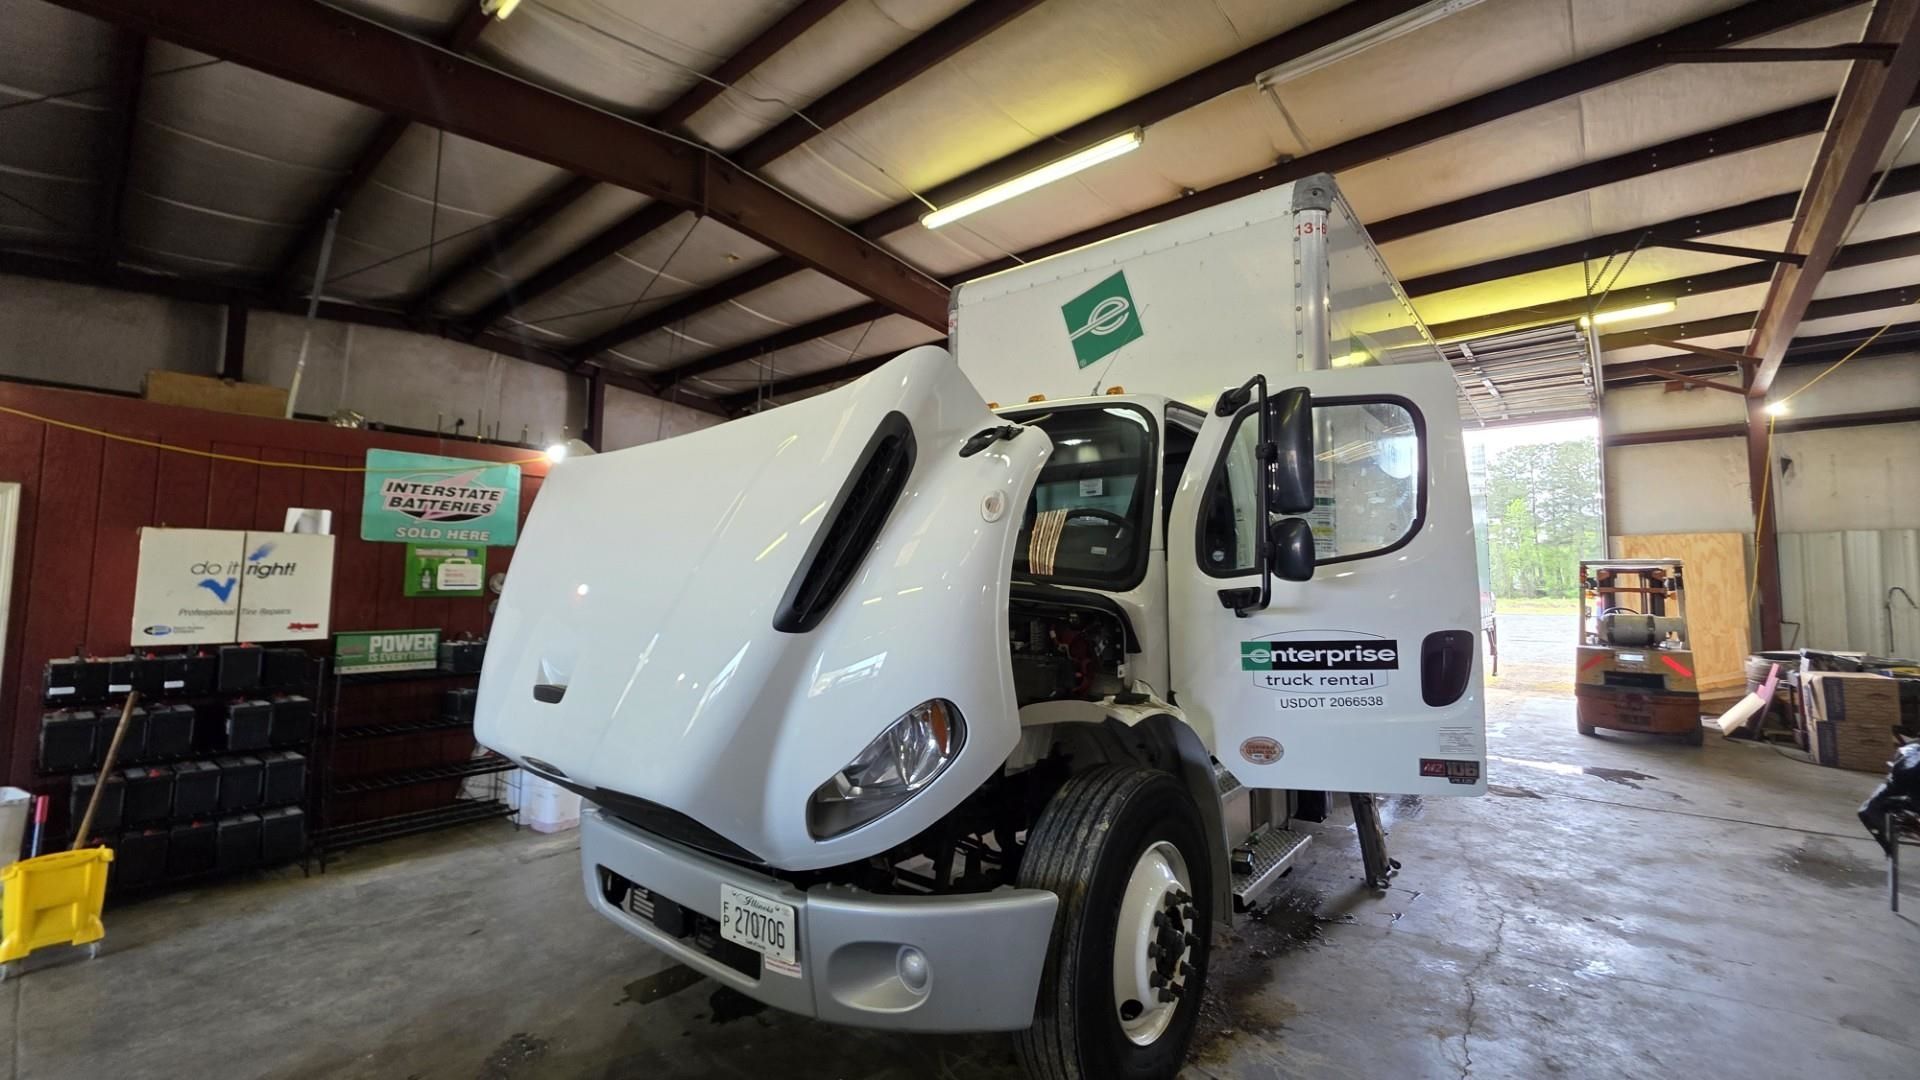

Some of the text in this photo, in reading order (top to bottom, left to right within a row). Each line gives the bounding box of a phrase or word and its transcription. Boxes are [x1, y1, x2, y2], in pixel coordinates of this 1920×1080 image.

[386, 481, 501, 501] INTERSTATE
[388, 496, 493, 514] BATTERIES
[395, 527, 490, 541] SOLD HERE
[190, 560, 297, 579] do it right!
[369, 633, 436, 653] POWER
[379, 651, 436, 662] EVERYT
[1250, 645, 1396, 667] enterprise
[1265, 672, 1374, 686] truck rental
[1280, 696, 1383, 709] USDOT 2066538
[735, 906, 785, 949] 270706
